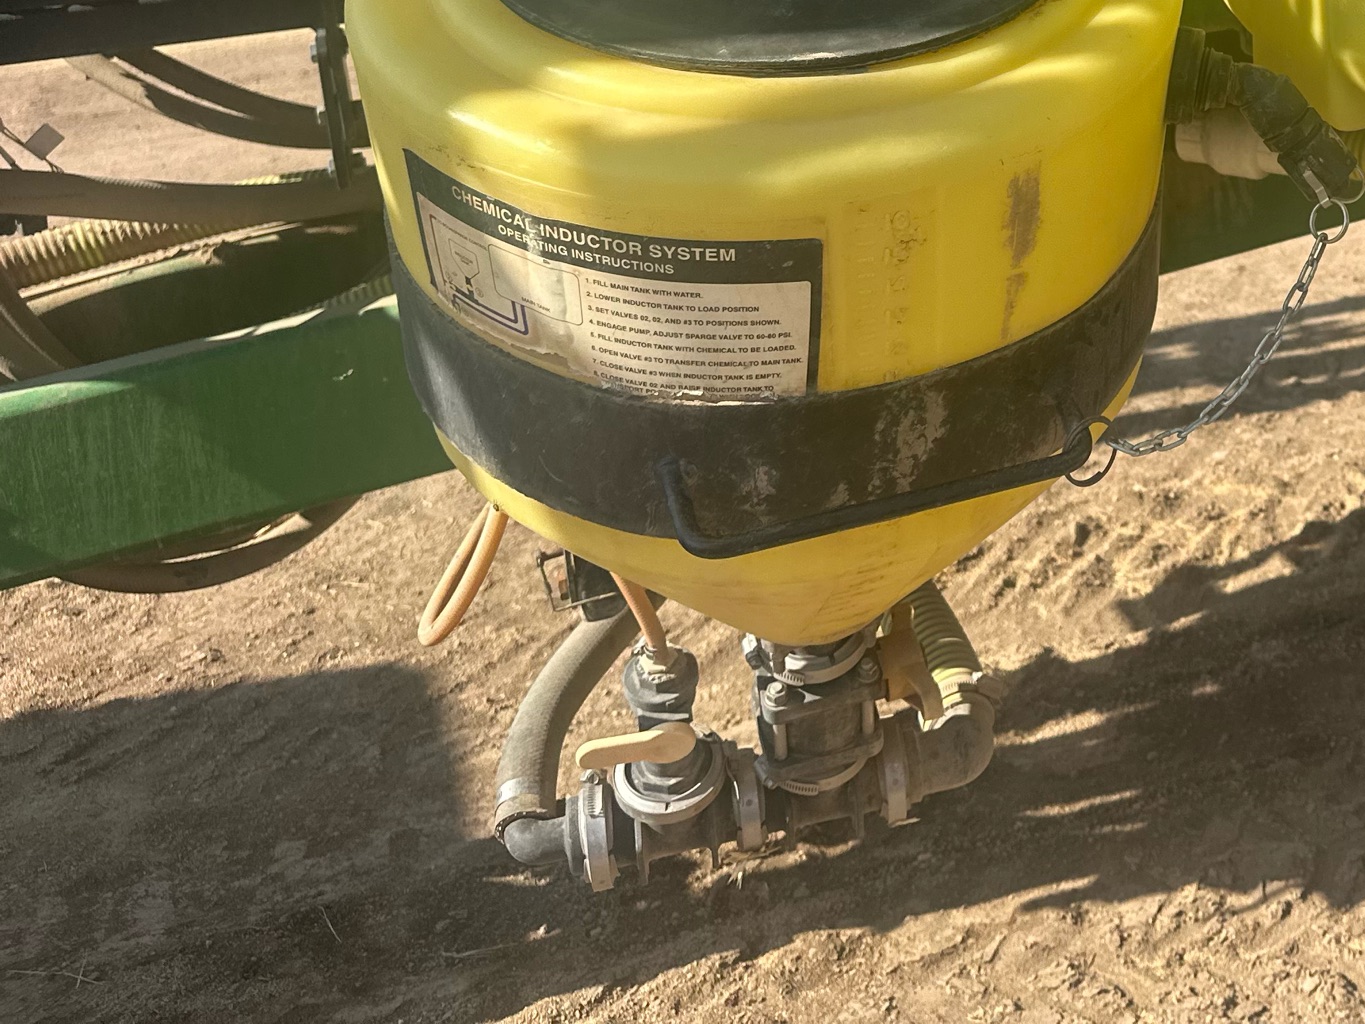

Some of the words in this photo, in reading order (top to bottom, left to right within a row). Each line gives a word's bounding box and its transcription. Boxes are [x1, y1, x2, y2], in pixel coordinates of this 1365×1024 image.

[451, 185, 538, 233] CHEMICAL
[540, 223, 642, 256] INDUCTOR
[649, 244, 736, 262] SYSTEM
[498, 225, 568, 256] OPERATING
[571, 248, 675, 274] INSTRUCTIONS
[593, 279, 609, 288] FILL
[610, 282, 629, 292] MAIN
[630, 286, 651, 295] TANK
[652, 288, 672, 297] WITH
[673, 291, 704, 299] WATER.
[594, 293, 621, 303] LOWER
[622, 298, 662, 309] INDUCTOR
[595, 306, 609, 315] SET
[610, 310, 639, 320] VALVES
[664, 317, 681, 325] AND
[706, 319, 749, 327] POSITIONS
[750, 319, 782, 327] SHOWN.
[596, 320, 628, 332] ENGAGE
[653, 330, 684, 339] ADJUST
[597, 333, 613, 342] FILL
[614, 337, 653, 349] INDUCTOR
[653, 343, 674, 351] TANK
[696, 346, 737, 354] CHEMICAL
[763, 344, 797, 353] LOADED.
[598, 346, 619, 357] OPEN
[620, 351, 642, 361] VALVE
[665, 358, 706, 367] TRANSFER
[782, 357, 804, 365] TANK.
[599, 360, 624, 371] CLOSE
[624, 365, 648, 375] VALVE
[683, 373, 723, 381] INDUCTOR
[755, 372, 782, 380] EMPTY.
[600, 372, 625, 383] CLOSE
[625, 377, 648, 387] VALVE
